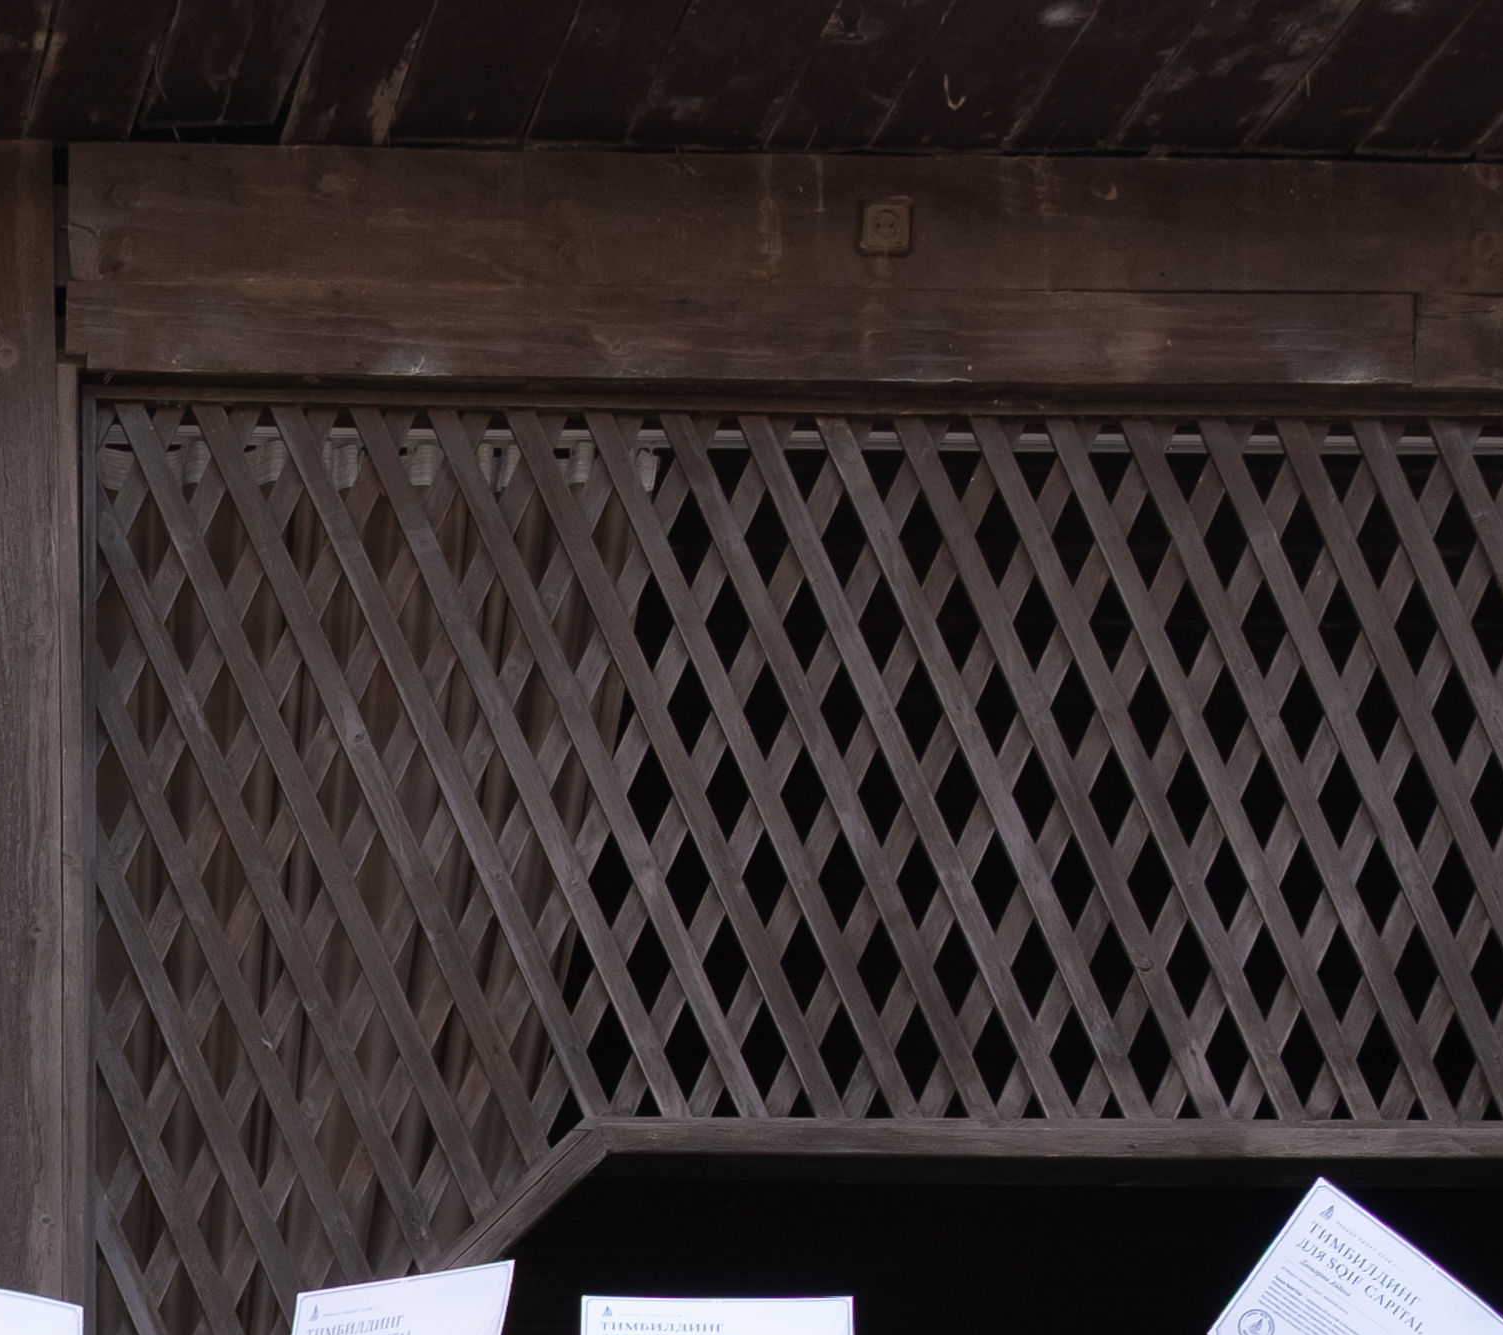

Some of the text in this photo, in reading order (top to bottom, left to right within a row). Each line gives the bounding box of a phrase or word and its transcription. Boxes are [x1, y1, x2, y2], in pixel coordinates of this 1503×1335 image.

[1296, 1237, 1323, 1260] ДЛЯ
[1326, 1256, 1364, 1288] SQIF
[1364, 1284, 1424, 1335] CAPITAL
[1309, 1219, 1421, 1307] ТИМБИЛДИНГ
